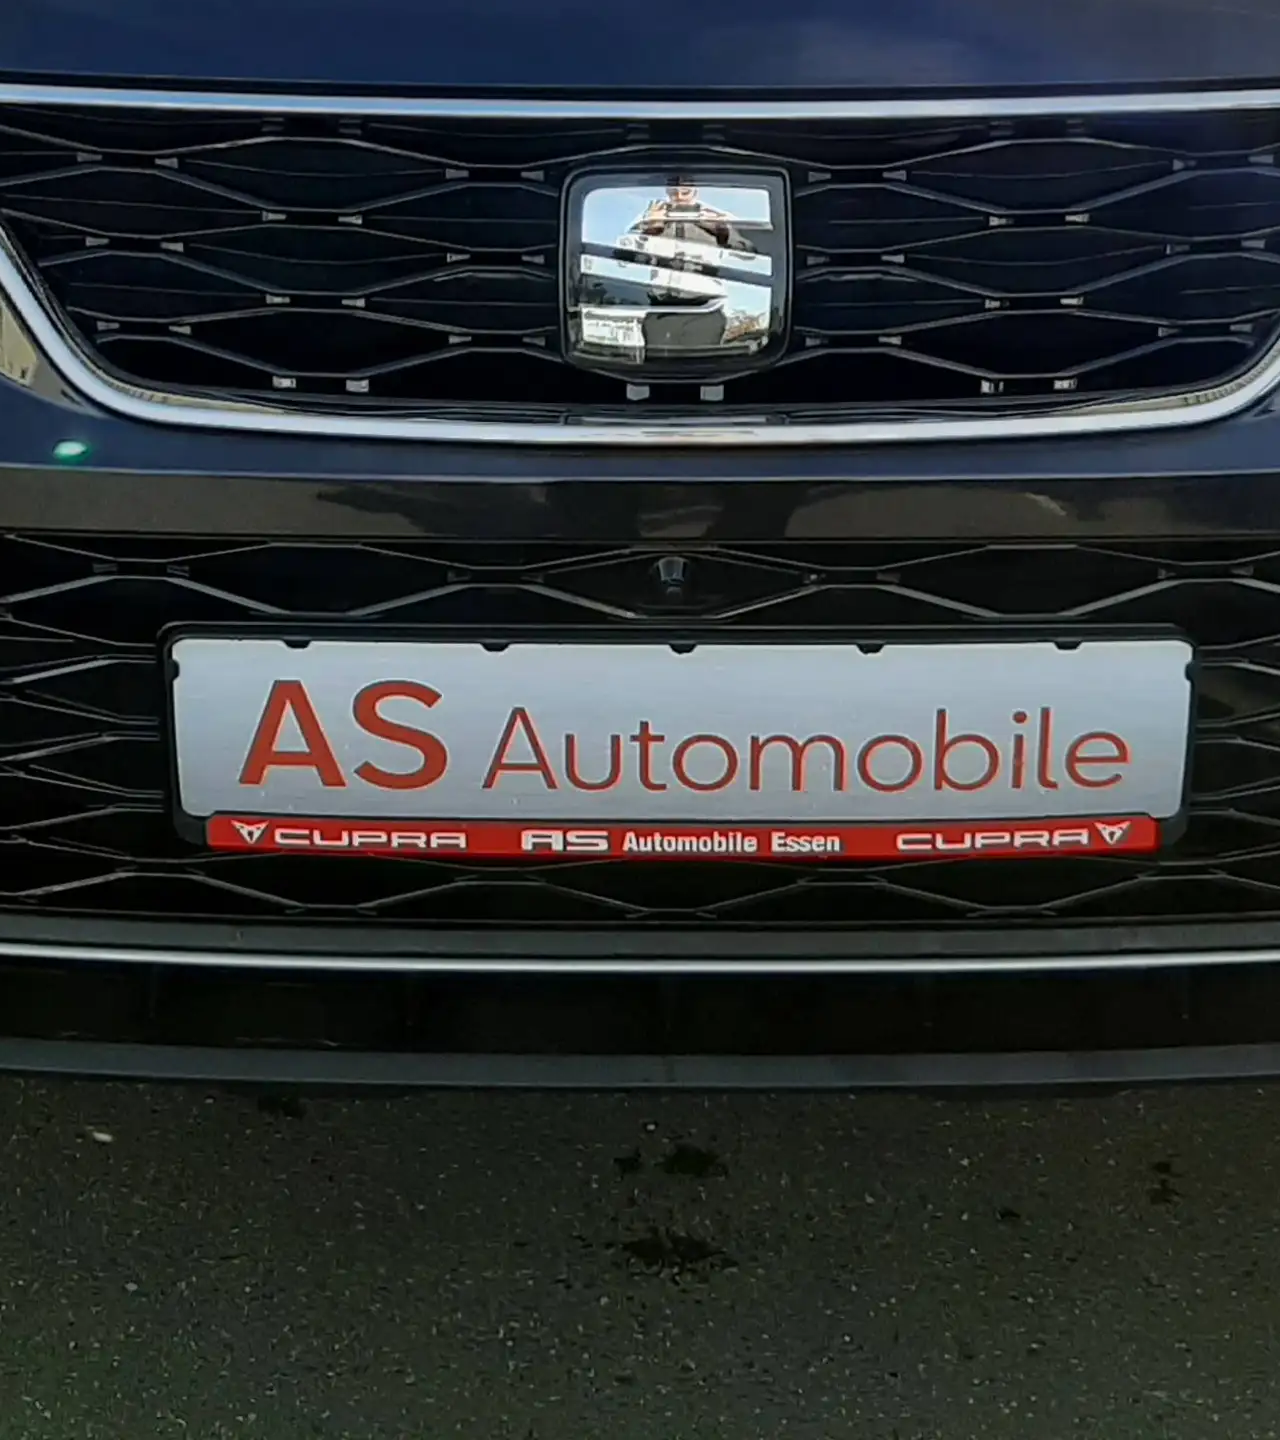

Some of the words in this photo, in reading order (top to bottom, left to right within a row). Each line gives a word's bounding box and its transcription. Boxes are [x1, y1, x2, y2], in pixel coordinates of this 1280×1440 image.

[238, 678, 449, 791] AS
[481, 705, 1131, 793] Automobile
[273, 828, 468, 851] CUPRA
[621, 829, 758, 854] Automobile
[770, 830, 841, 854] Essen
[894, 827, 1090, 851] CUPRA
